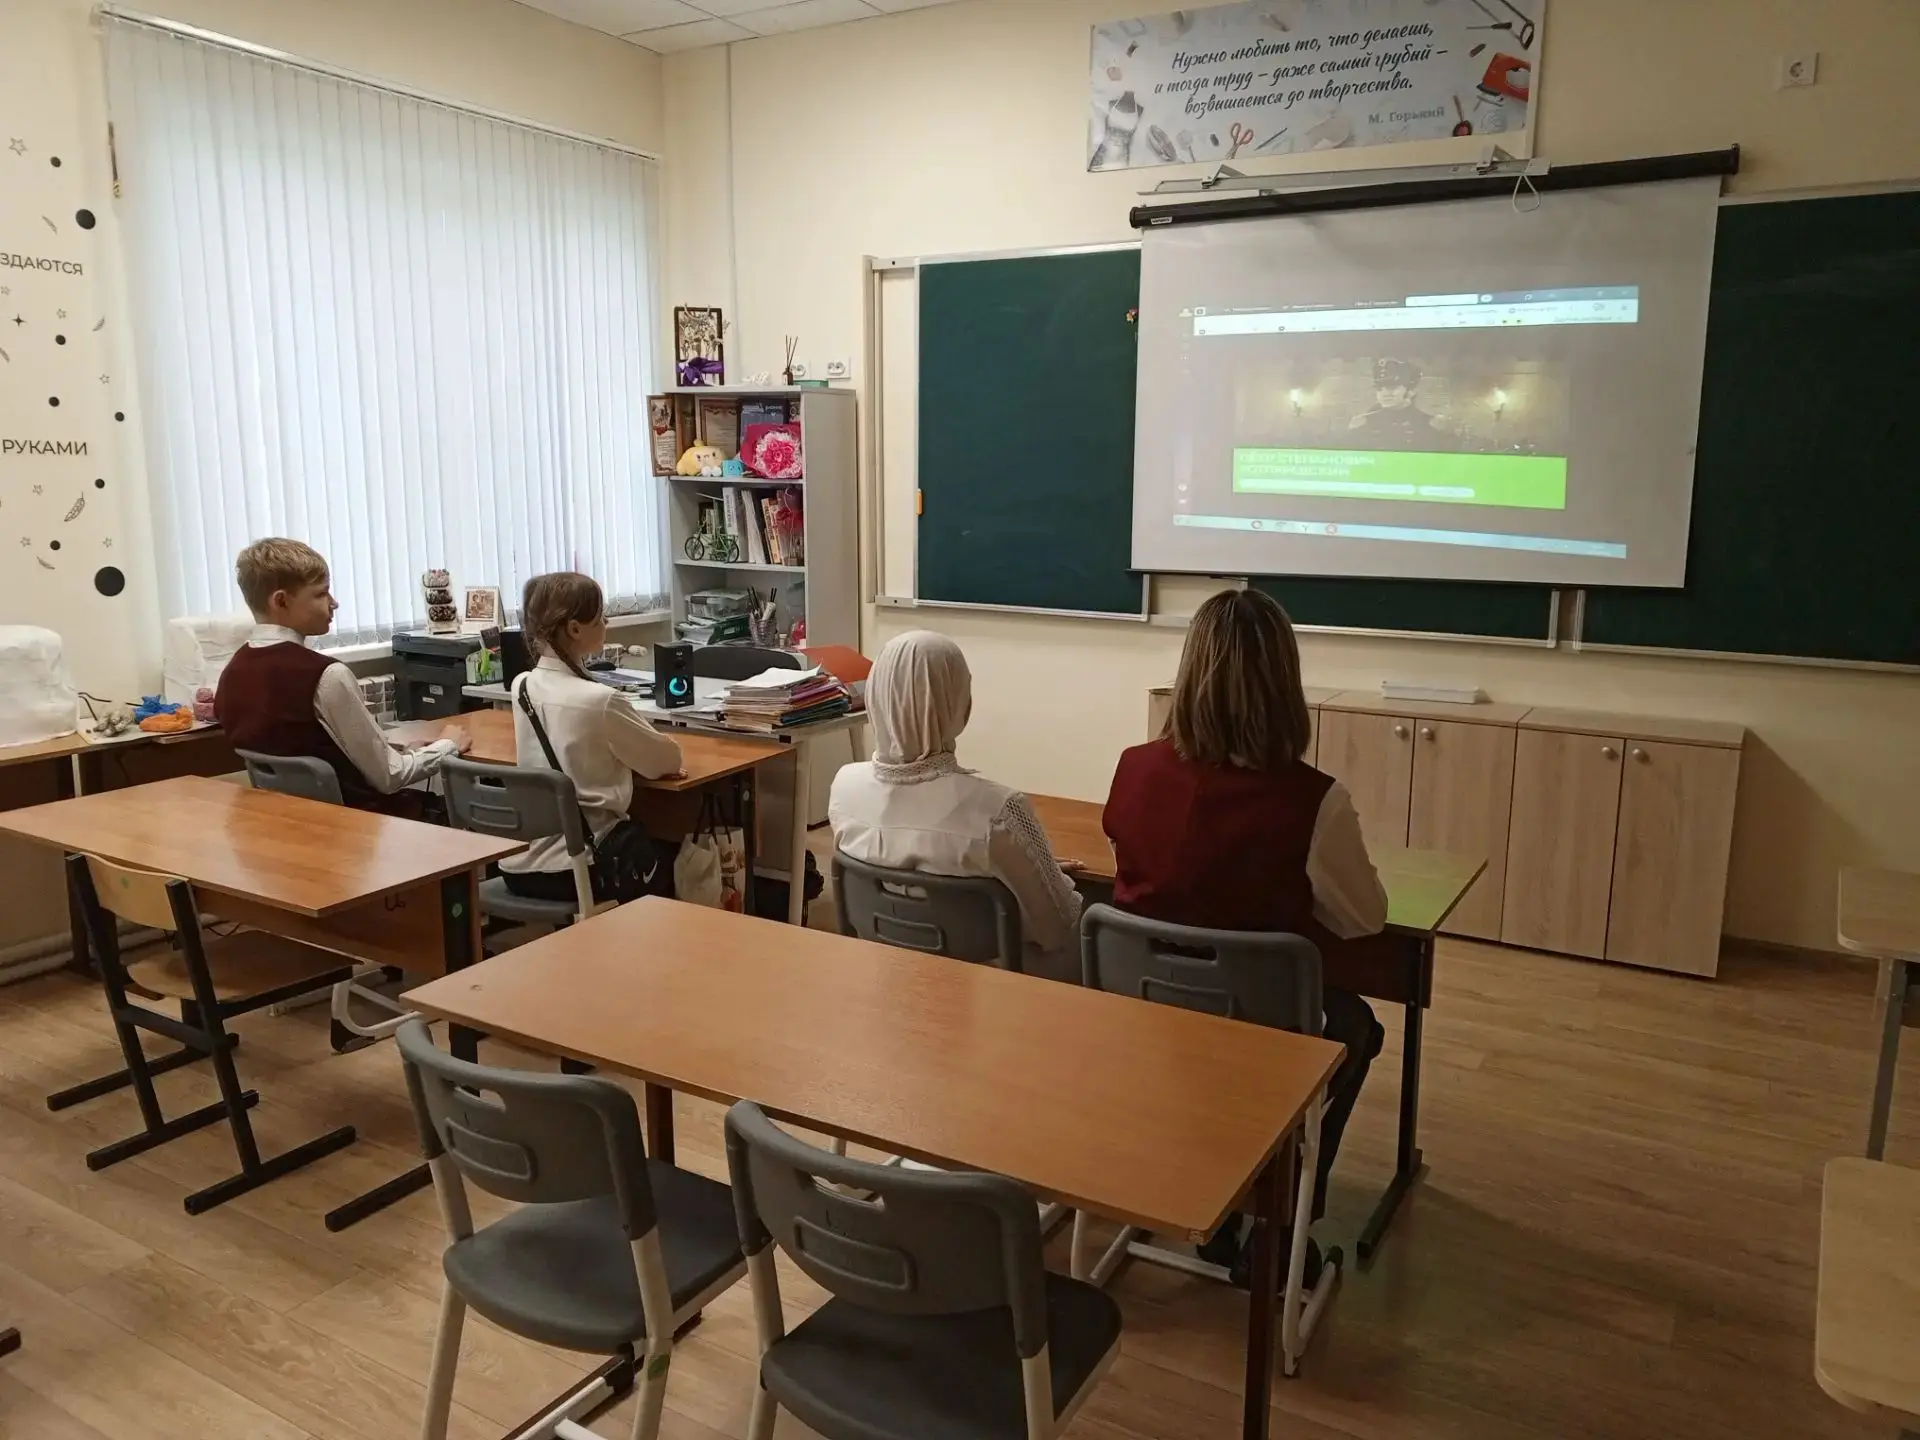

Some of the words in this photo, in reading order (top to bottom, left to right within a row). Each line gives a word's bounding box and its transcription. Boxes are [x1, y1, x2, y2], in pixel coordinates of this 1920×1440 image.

[1171, 51, 1227, 74] Нужно
[1230, 40, 1290, 61] любить
[1294, 38, 1321, 52] то,
[1328, 32, 1360, 47] что
[1360, 22, 1434, 50] делаешь,
[1154, 83, 1163, 94] и
[1166, 77, 1210, 96] тогда
[1212, 71, 1253, 92] труд
[1269, 63, 1316, 87] даже
[1319, 51, 1372, 74] самый
[1374, 43, 1433, 73] грубый
[1184, 94, 1283, 119] возвышается
[1283, 89, 1305, 110] до
[1308, 71, 1413, 104] творчества.
[1368, 114, 1384, 125] М.
[1389, 106, 1446, 124] Горький
[0, 252, 83, 276] ЗДАЮТСЯ
[2, 438, 88, 456] РУКАМИ
